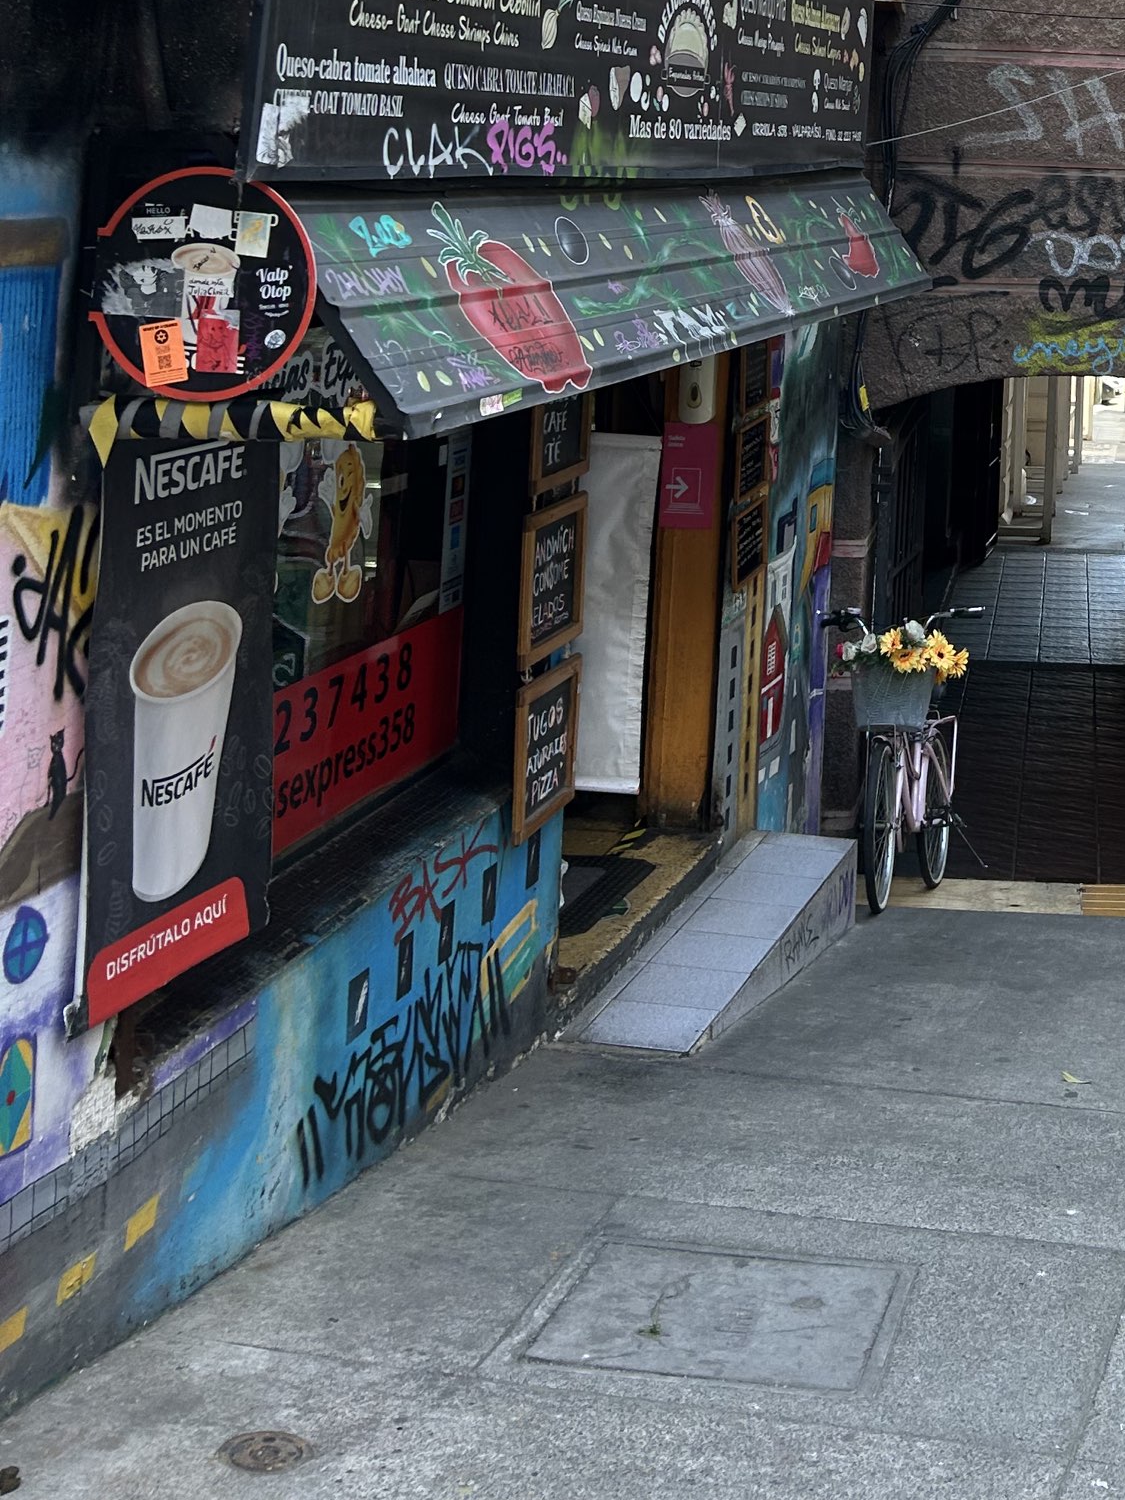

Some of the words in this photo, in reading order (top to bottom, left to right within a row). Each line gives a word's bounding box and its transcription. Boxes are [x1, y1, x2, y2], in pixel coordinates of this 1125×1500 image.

[397, 3, 420, 34] Goat
[494, 21, 519, 48] Chives
[276, 43, 351, 82] Queso-cabra
[354, 55, 390, 84] tomate
[393, 55, 436, 88] albahaca
[444, 62, 474, 91] QUESO
[476, 66, 503, 92] CABRA
[505, 69, 537, 96] TOMATE
[538, 71, 574, 97] ALBAHACA
[341, 91, 379, 116] TOMATO
[380, 95, 403, 118] BASIL
[452, 102, 486, 124] Cheese
[489, 102, 511, 123] Goat
[514, 105, 540, 126] Tomato
[544, 107, 564, 127] Basil
[629, 115, 651, 138] Mas
[654, 118, 666, 139] de
[669, 119, 682, 139] 80
[684, 116, 731, 141] variedades
[543, 402, 568, 434] CAFÉ
[136, 525, 152, 548] ES
[155, 521, 171, 541] EL
[174, 500, 243, 535] MOMENTO
[141, 544, 177, 572] PARA
[180, 536, 200, 559] UN
[203, 522, 237, 552] CAFÉ
[534, 525, 574, 569] ANDWICH
[531, 594, 565, 627] ELADOS
[527, 697, 563, 747] JUGOS
[141, 735, 217, 807] NESCAFÉ
[272, 703, 415, 819] sexpress358
[526, 732, 567, 778] ATURALES
[106, 918, 191, 981] DISFRÚTALO
[194, 894, 228, 930] AQUÍ
